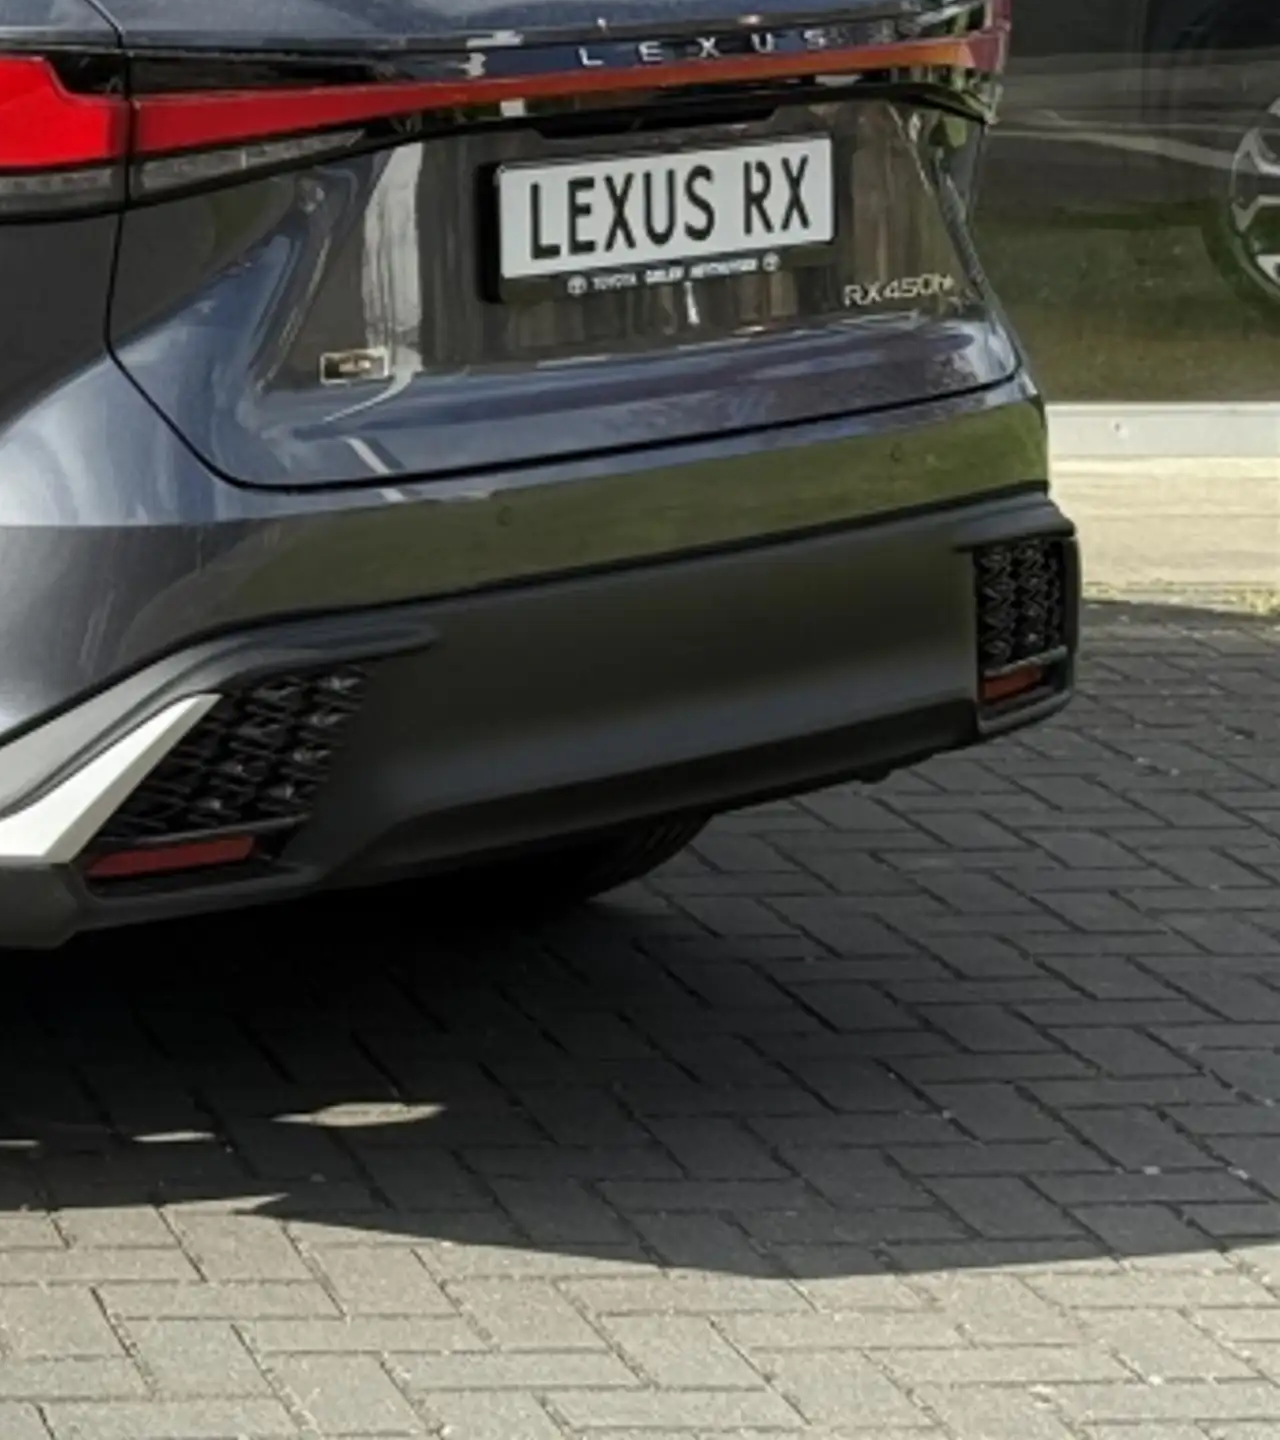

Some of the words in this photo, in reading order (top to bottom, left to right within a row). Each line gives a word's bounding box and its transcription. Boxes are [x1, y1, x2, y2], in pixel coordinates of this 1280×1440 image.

[578, 29, 827, 67] LEXUS
[529, 164, 717, 260] LEXUS
[743, 154, 811, 236] RX
